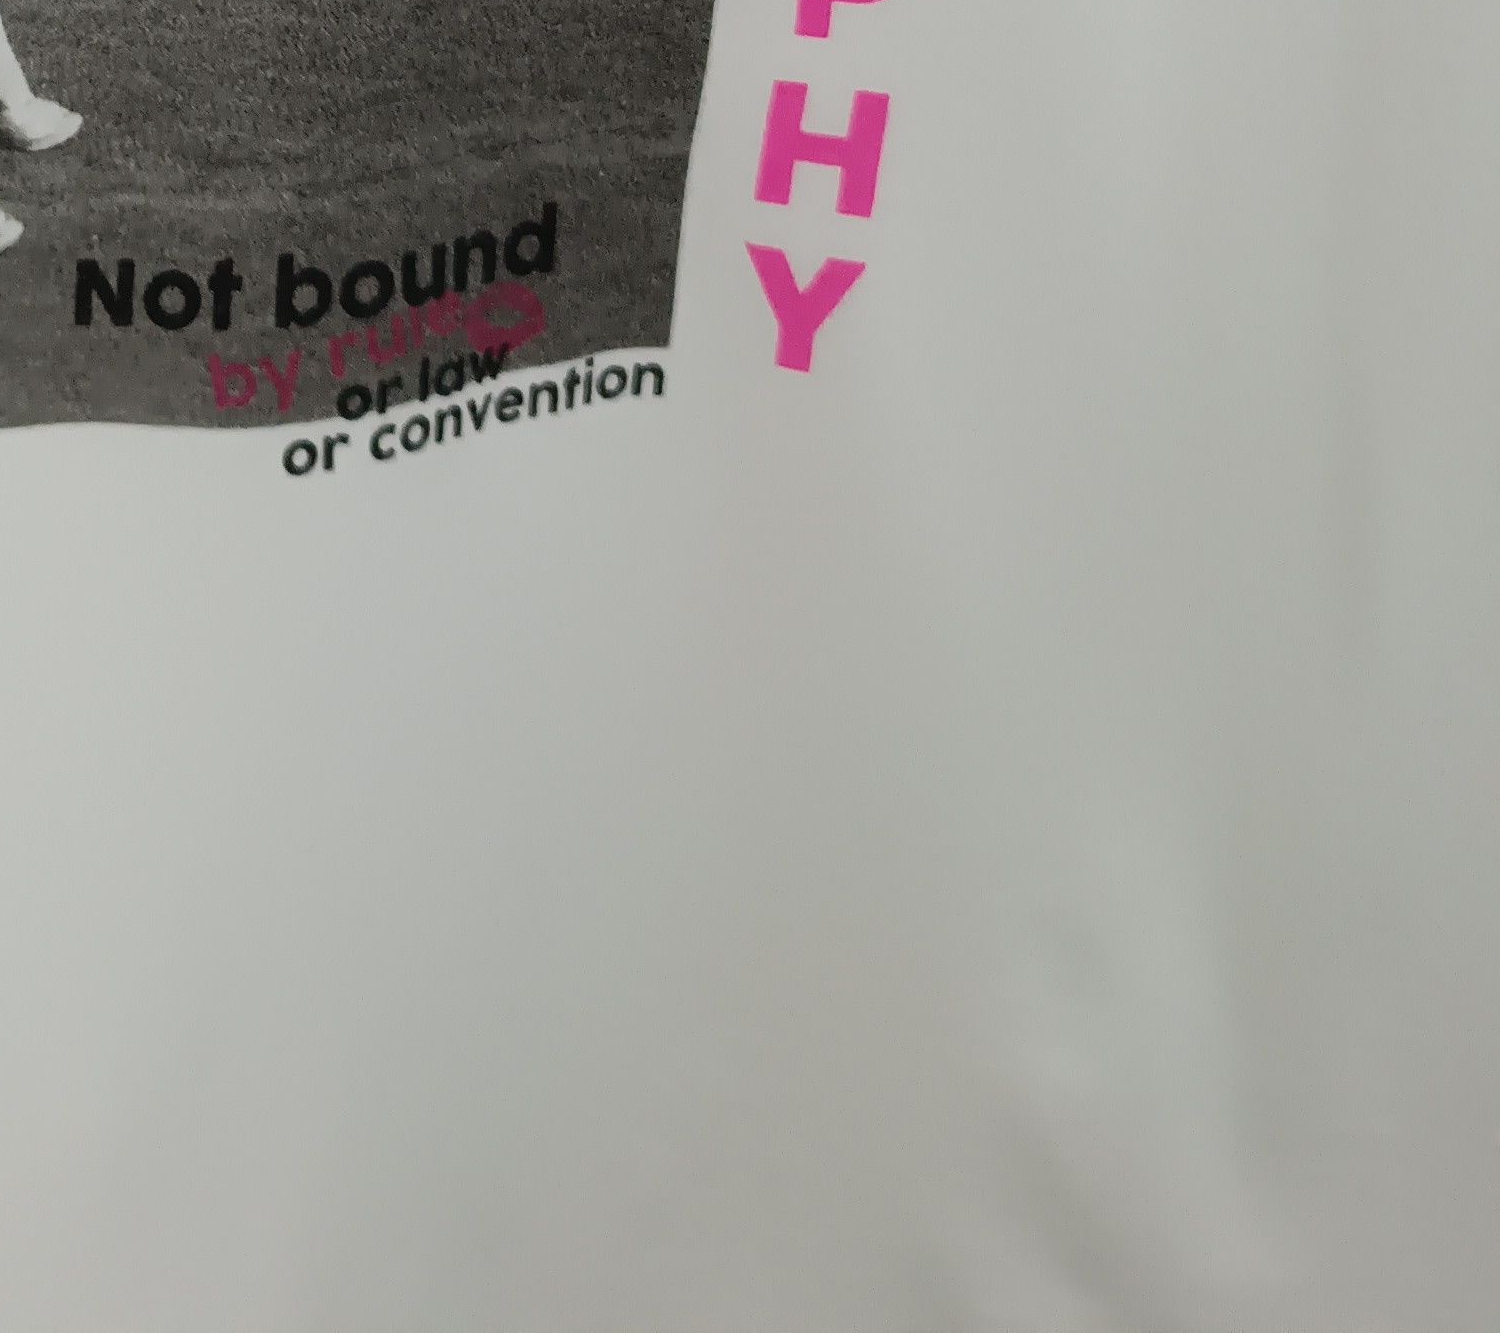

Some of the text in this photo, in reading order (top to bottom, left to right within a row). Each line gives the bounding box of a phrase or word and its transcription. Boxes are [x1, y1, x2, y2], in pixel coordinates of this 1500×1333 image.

[73, 201, 557, 331] Not bound
[206, 348, 304, 414] by
[282, 355, 665, 477] or convention
[336, 341, 510, 421] or law
